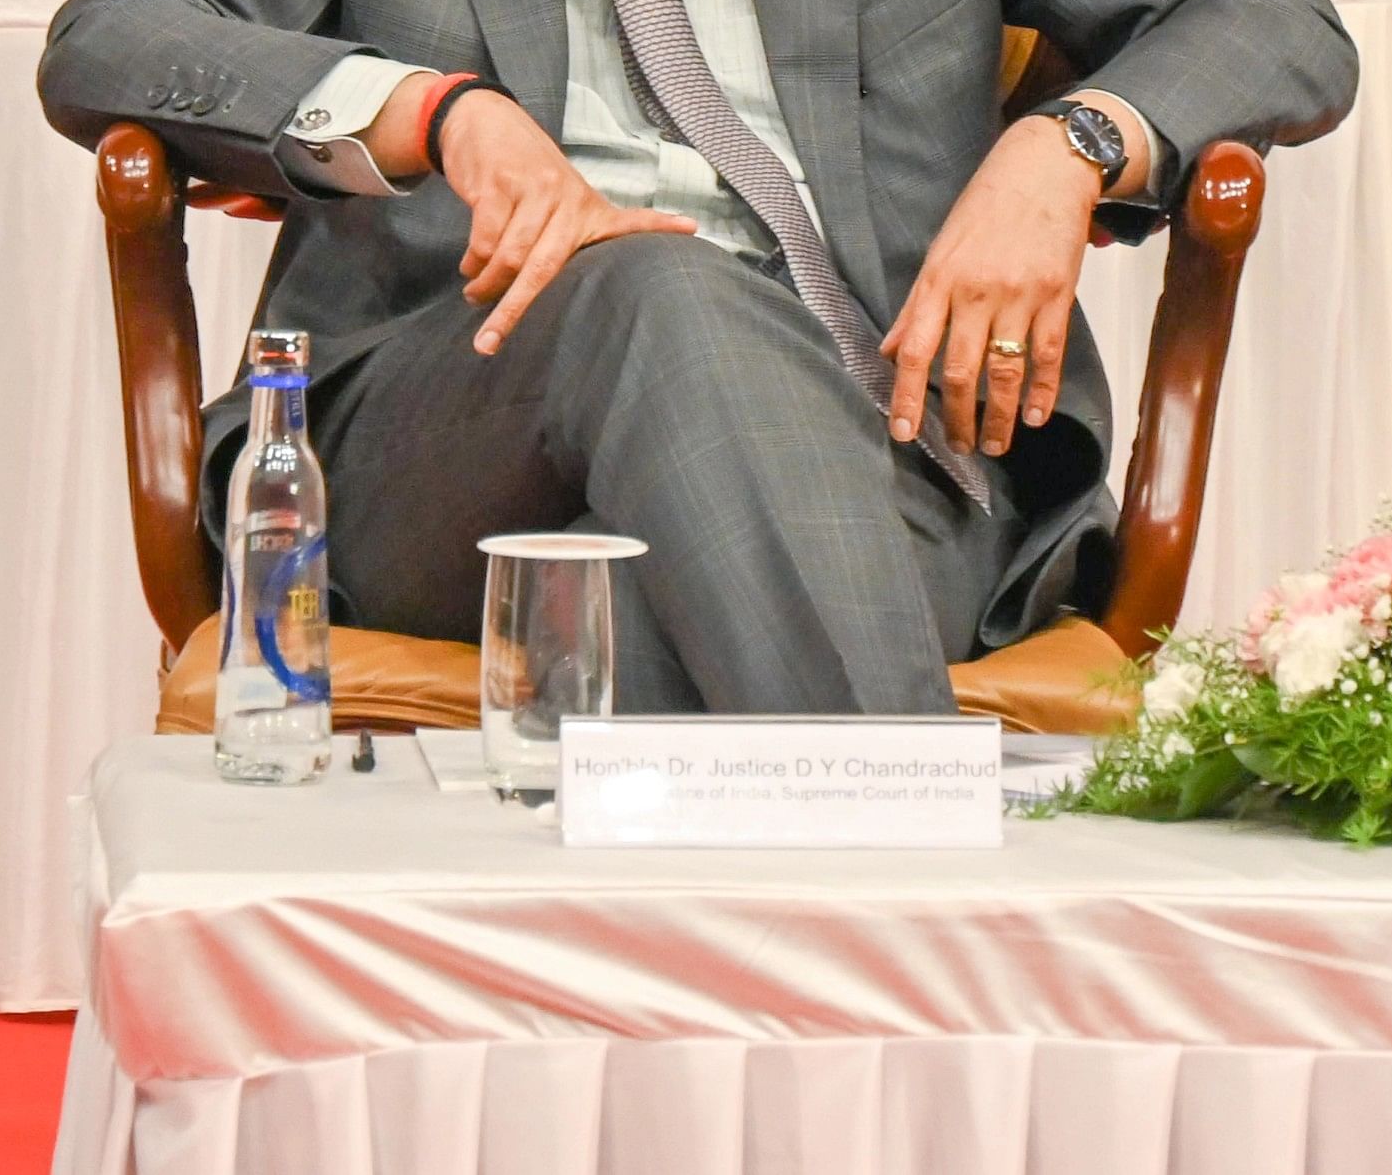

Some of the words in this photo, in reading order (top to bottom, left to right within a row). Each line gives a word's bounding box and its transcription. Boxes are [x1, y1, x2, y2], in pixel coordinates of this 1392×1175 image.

[668, 758, 698, 778] Dr.
[708, 758, 787, 778] Justice
[796, 758, 813, 778] D
[821, 759, 837, 777] Y
[844, 759, 997, 778] Chandrachud
[710, 786, 727, 801] of
[781, 786, 858, 804] Supreme
[863, 786, 909, 802] Court
[913, 786, 929, 801] of
[934, 786, 975, 801] India
